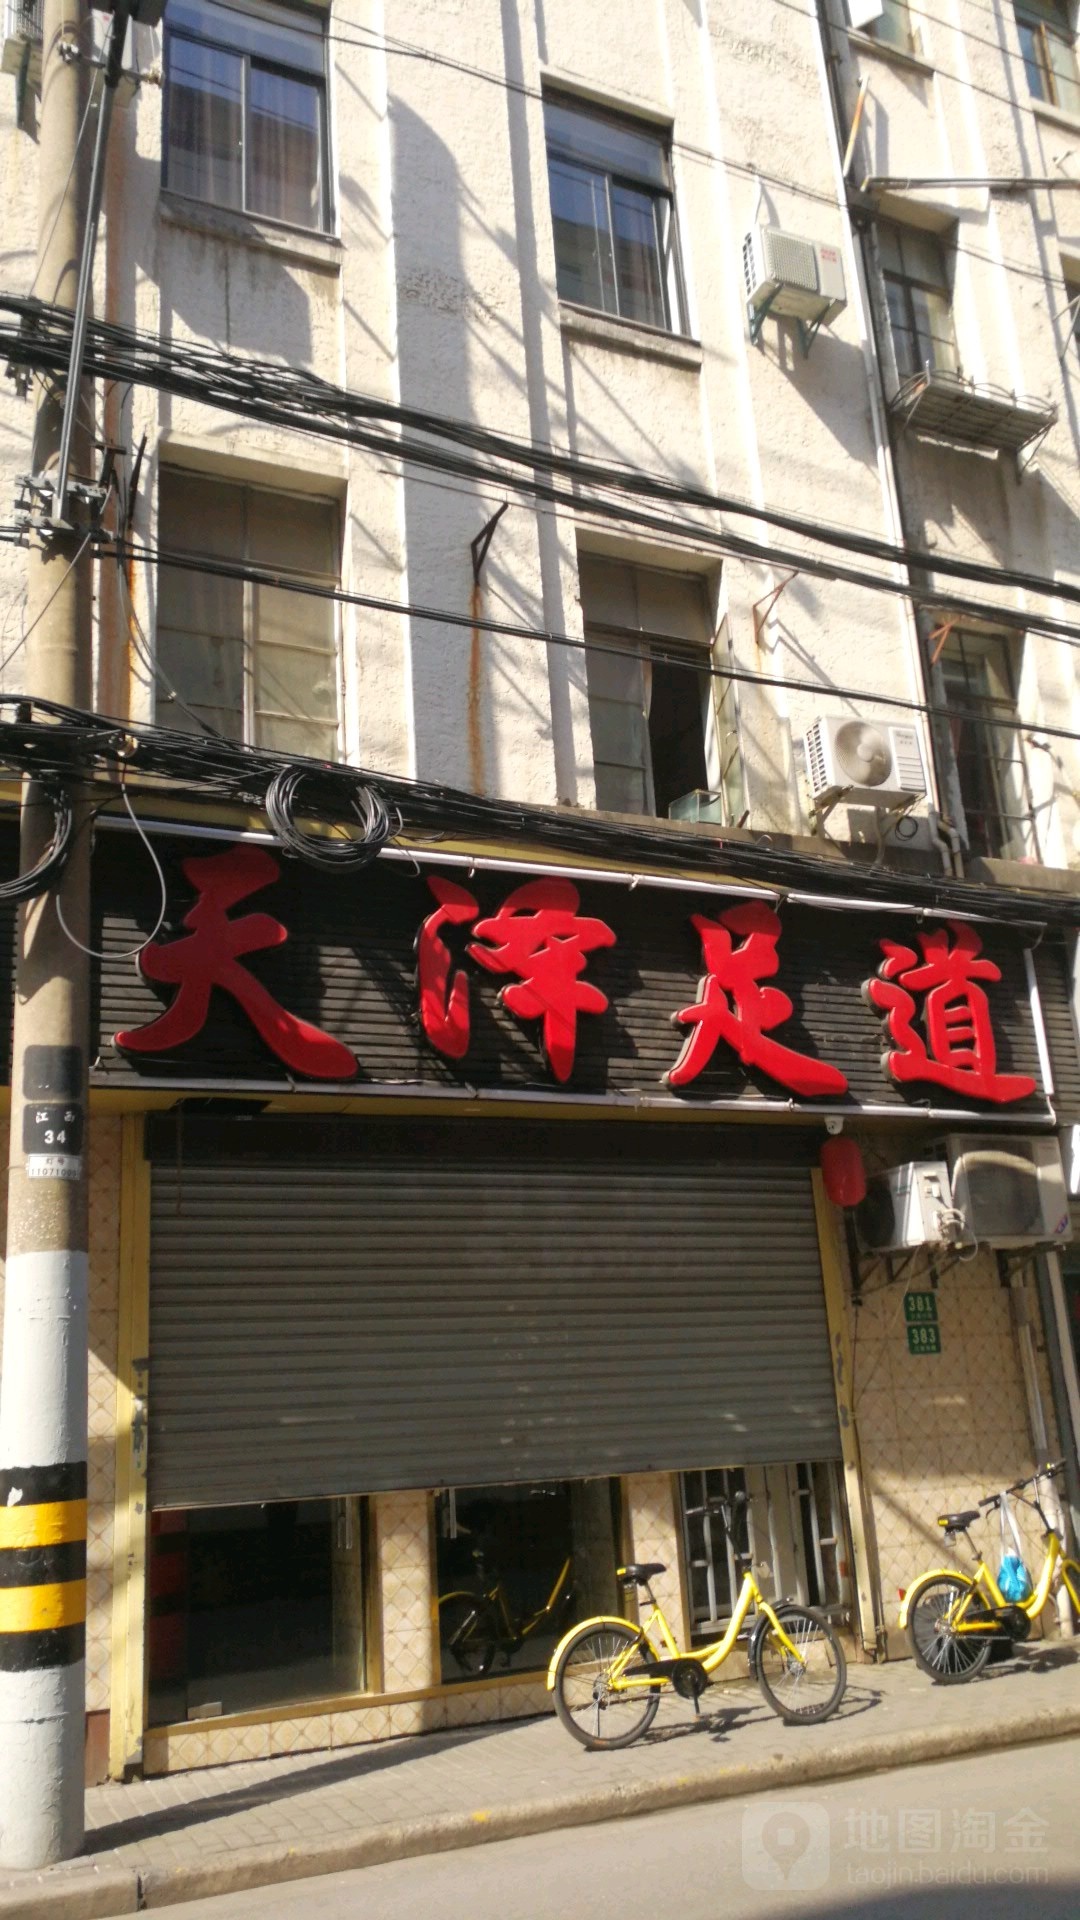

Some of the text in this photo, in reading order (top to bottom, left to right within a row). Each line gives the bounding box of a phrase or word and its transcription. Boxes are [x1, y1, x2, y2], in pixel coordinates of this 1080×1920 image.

[115, 845, 1037, 1103] 天泽足道
[44, 1129, 66, 1144] 34
[908, 1296, 932, 1311] 381
[912, 1328, 936, 1344] 383
